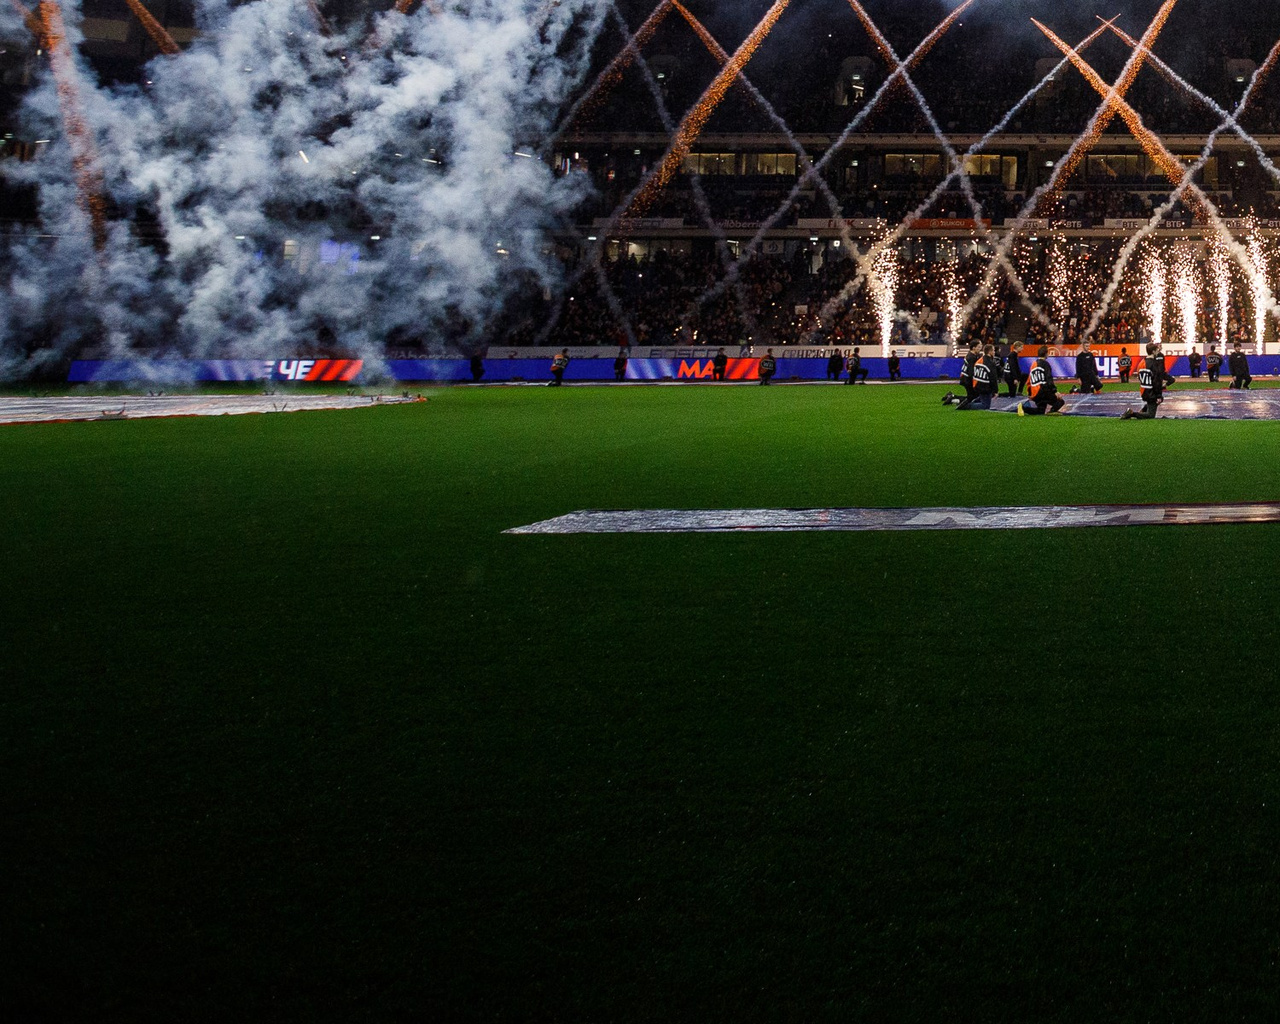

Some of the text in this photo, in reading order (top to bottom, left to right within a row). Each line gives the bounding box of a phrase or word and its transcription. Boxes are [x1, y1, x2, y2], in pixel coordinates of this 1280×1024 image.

[1066, 220, 1082, 228] ВТБ
[1122, 220, 1138, 228] ВТБ
[1166, 220, 1182, 228] ВТБ
